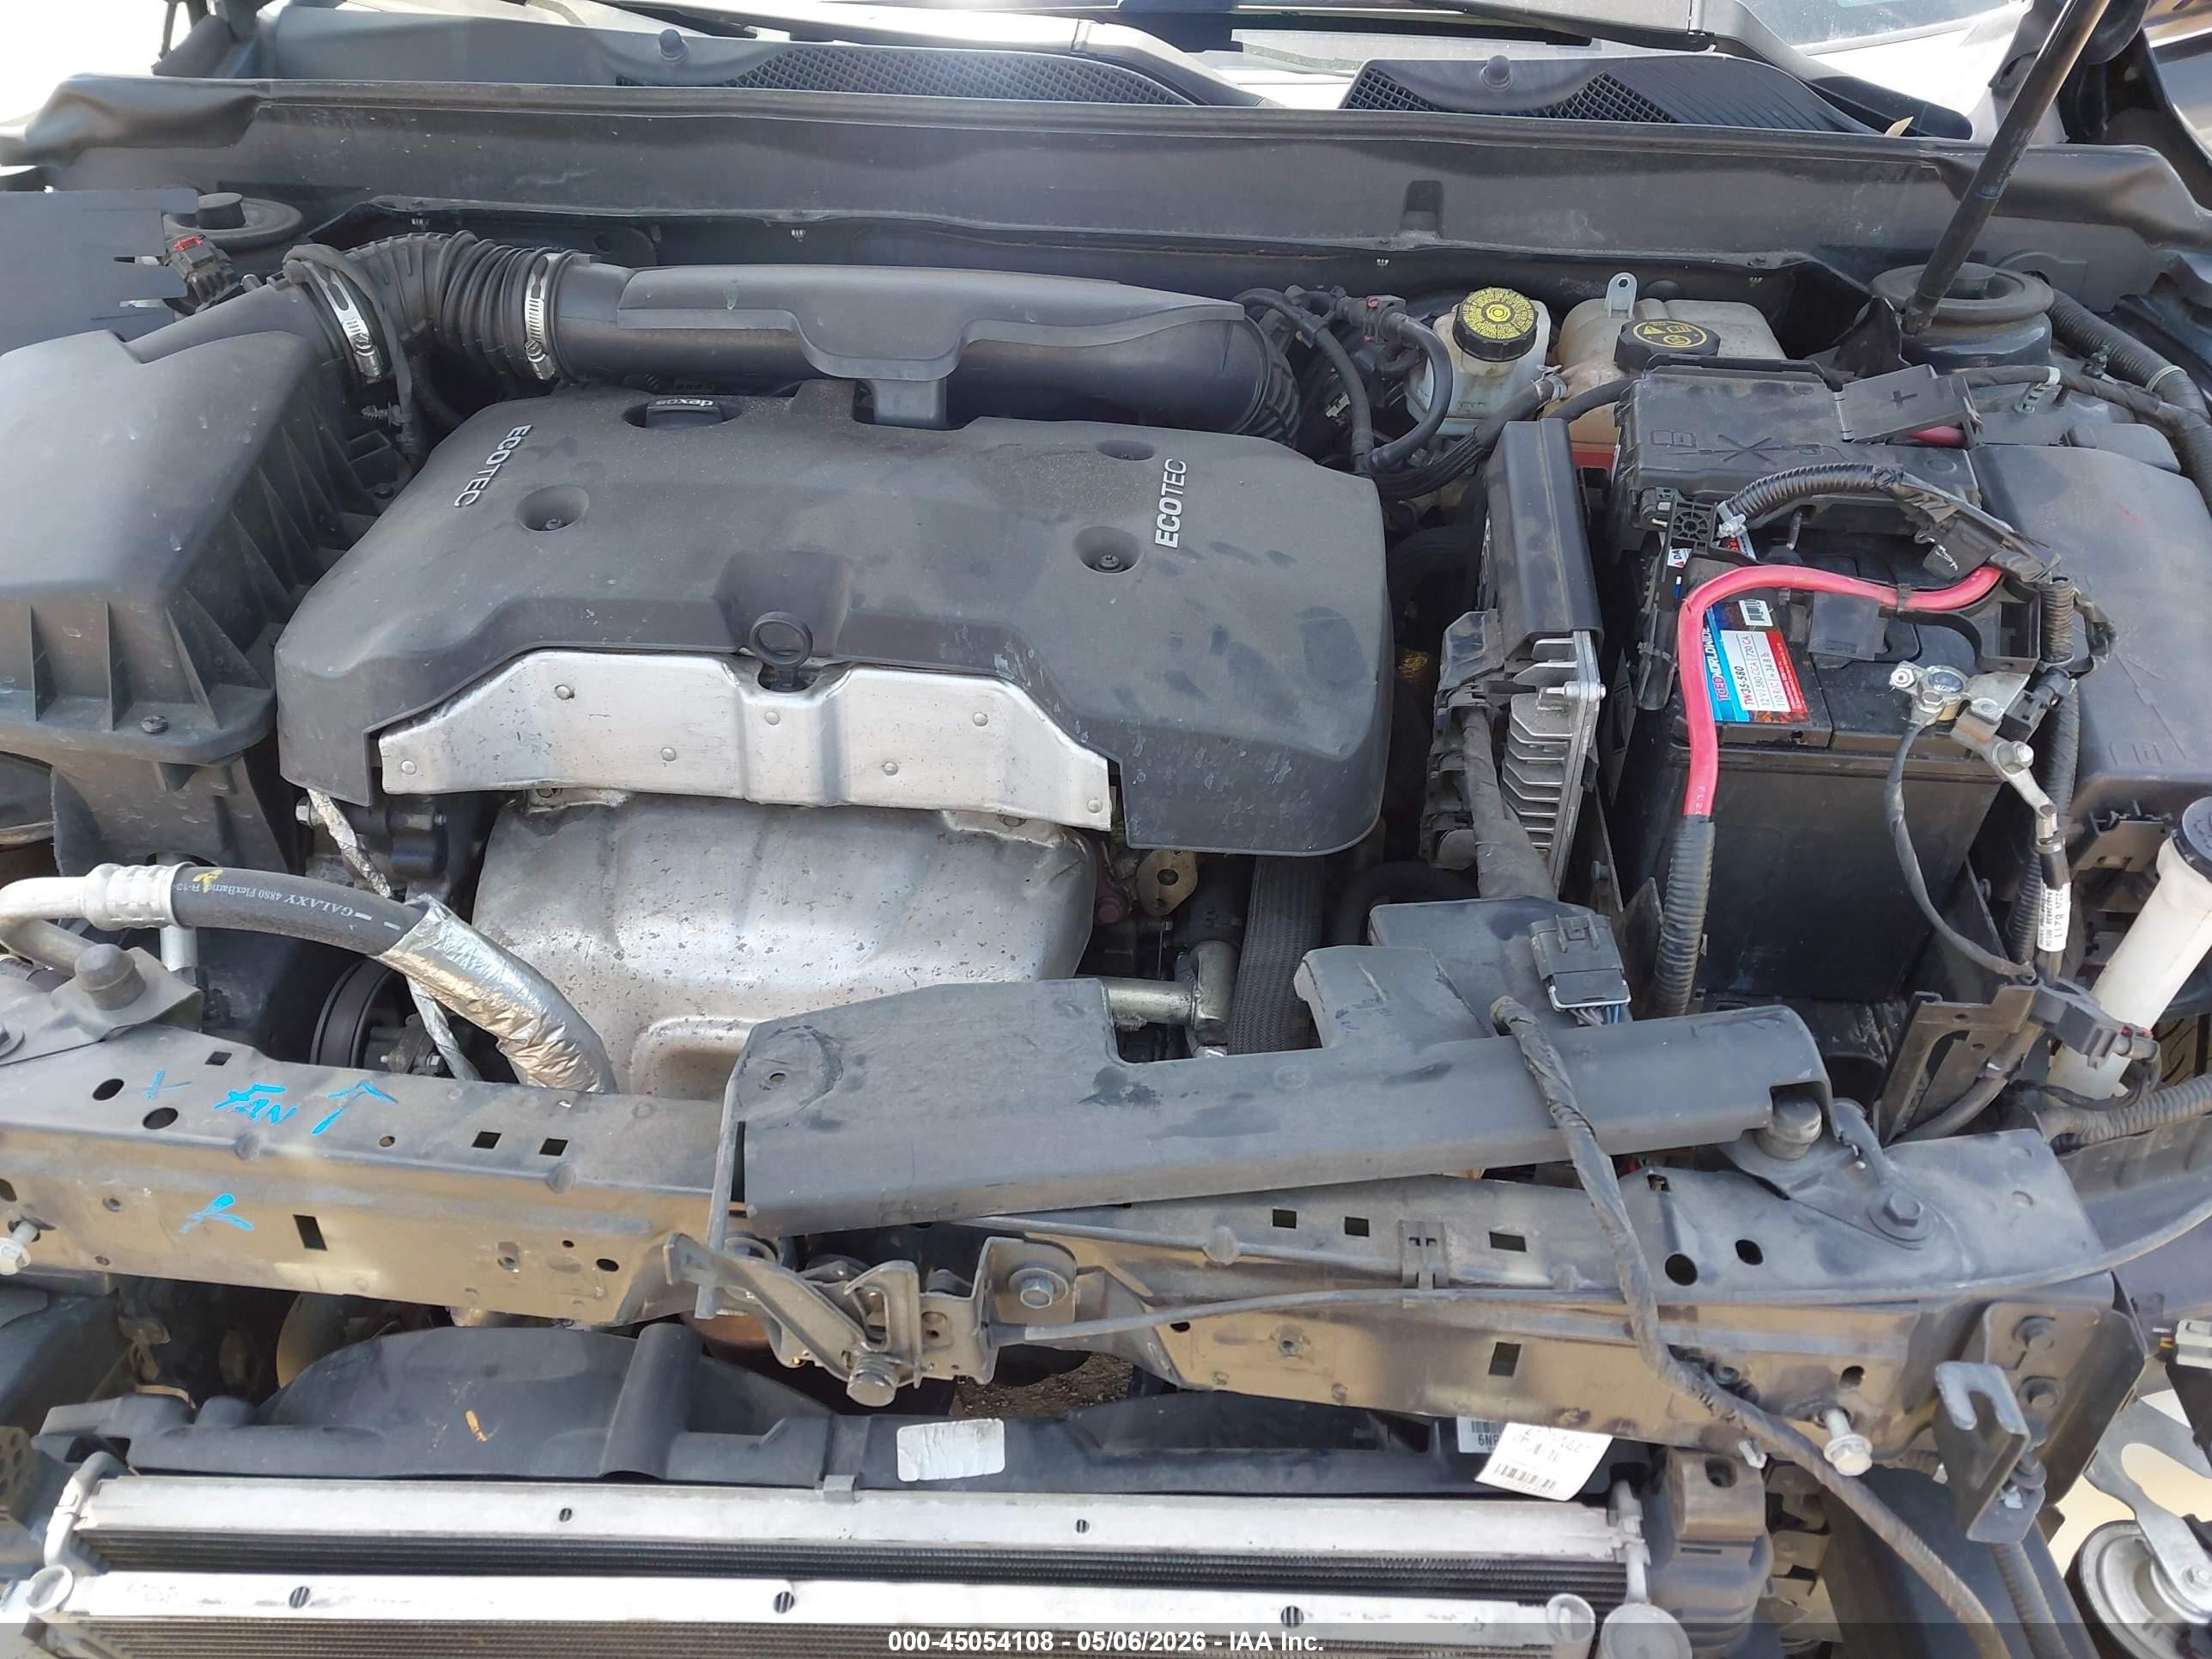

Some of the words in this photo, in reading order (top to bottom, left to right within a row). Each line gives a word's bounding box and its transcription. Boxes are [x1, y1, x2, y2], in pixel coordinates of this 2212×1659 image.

[453, 424, 532, 507] ECOTEC
[1155, 459, 1187, 549] ECOTEC
[1742, 635, 1751, 645] CA
[1750, 660, 1759, 675] CCA
[1734, 665, 1754, 705] TW35-580
[258, 890, 283, 901] 4880
[284, 894, 353, 916] GALAXY
[213, 1084, 298, 1126] FAN
